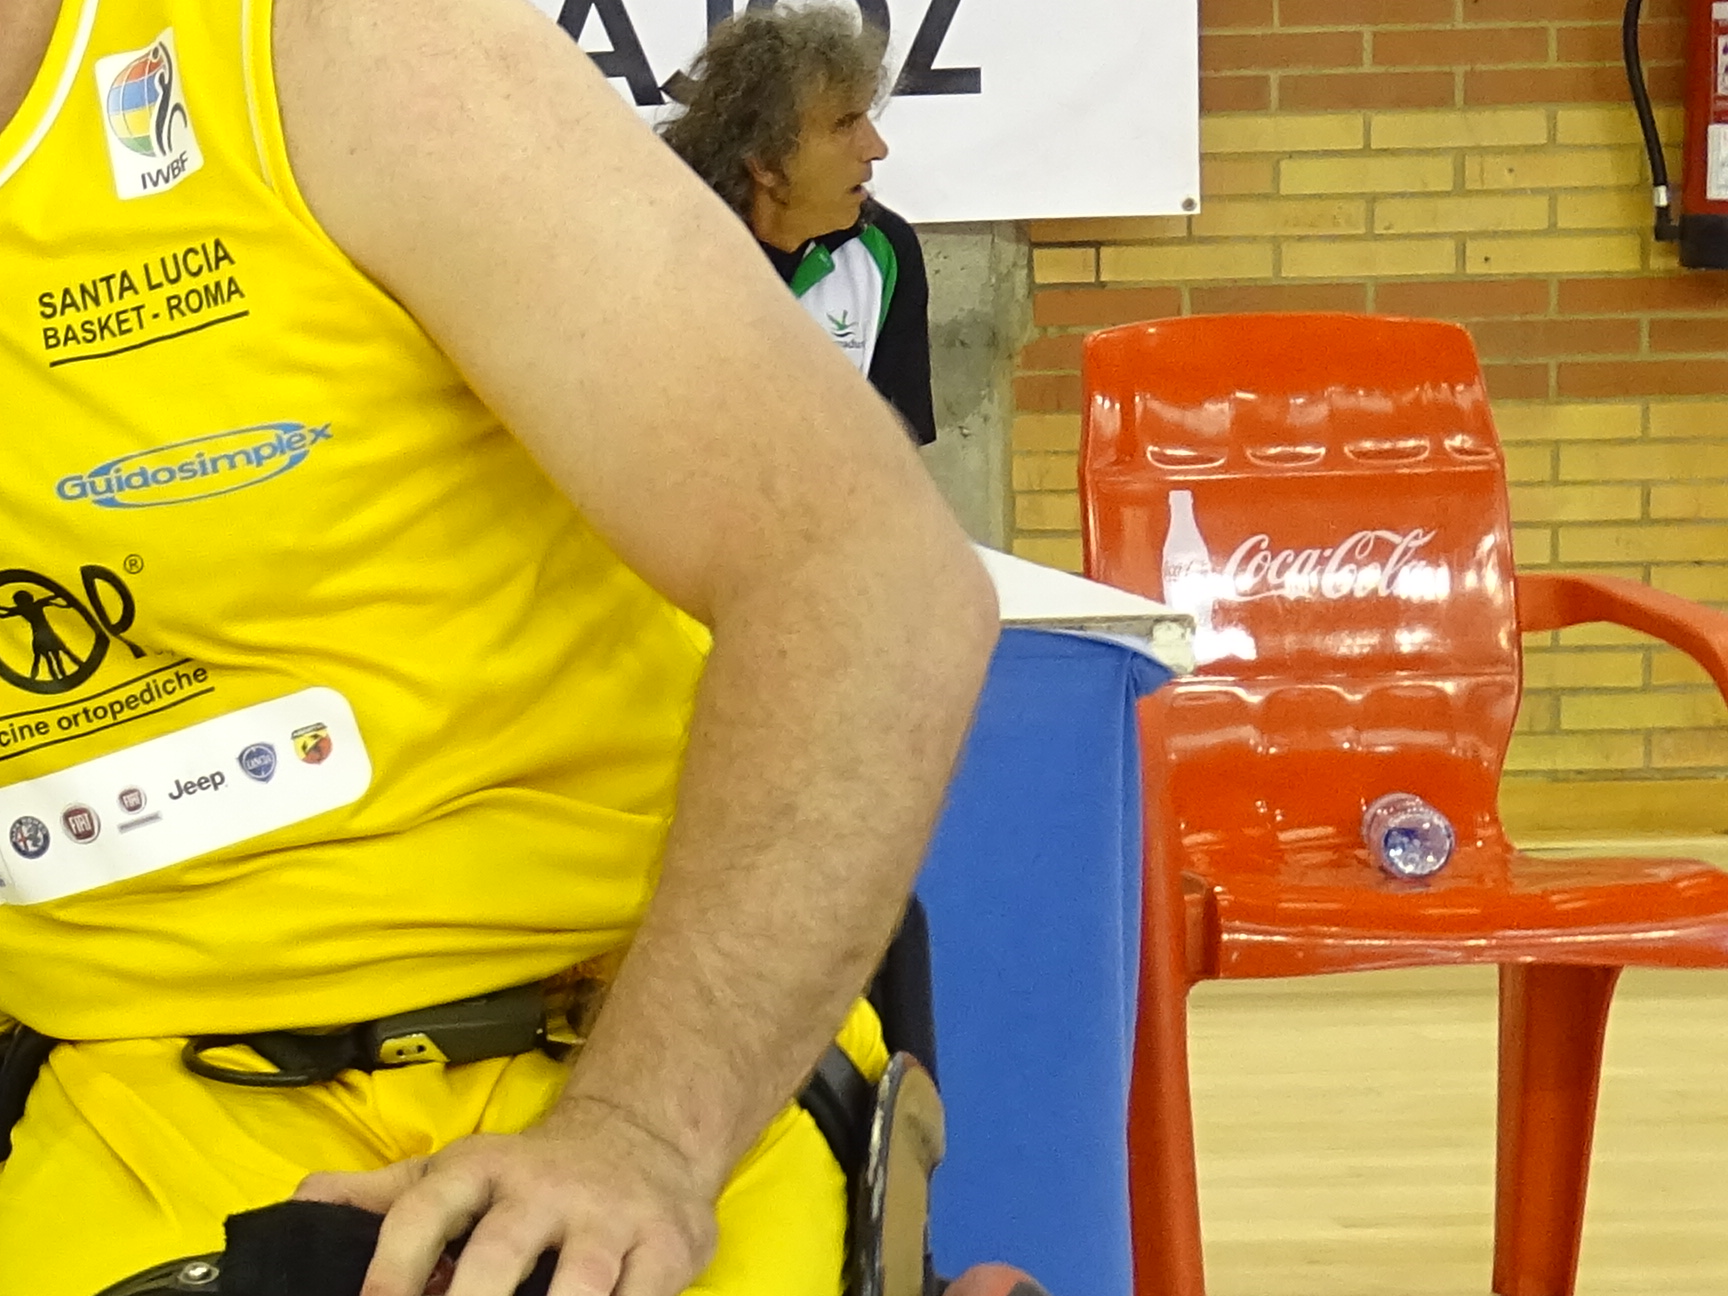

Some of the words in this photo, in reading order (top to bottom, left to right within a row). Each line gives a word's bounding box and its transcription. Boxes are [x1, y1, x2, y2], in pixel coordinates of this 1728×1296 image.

[141, 151, 189, 189] IWBF
[38, 269, 139, 320] SANTA
[144, 238, 236, 291] LUCIA
[43, 304, 146, 350] BASKET
[166, 276, 245, 321] ROMA
[56, 423, 332, 501] Guidosimplex
[57, 664, 208, 731] ortopediche
[168, 770, 226, 800] Jeep
[69, 813, 91, 835] FIAT
